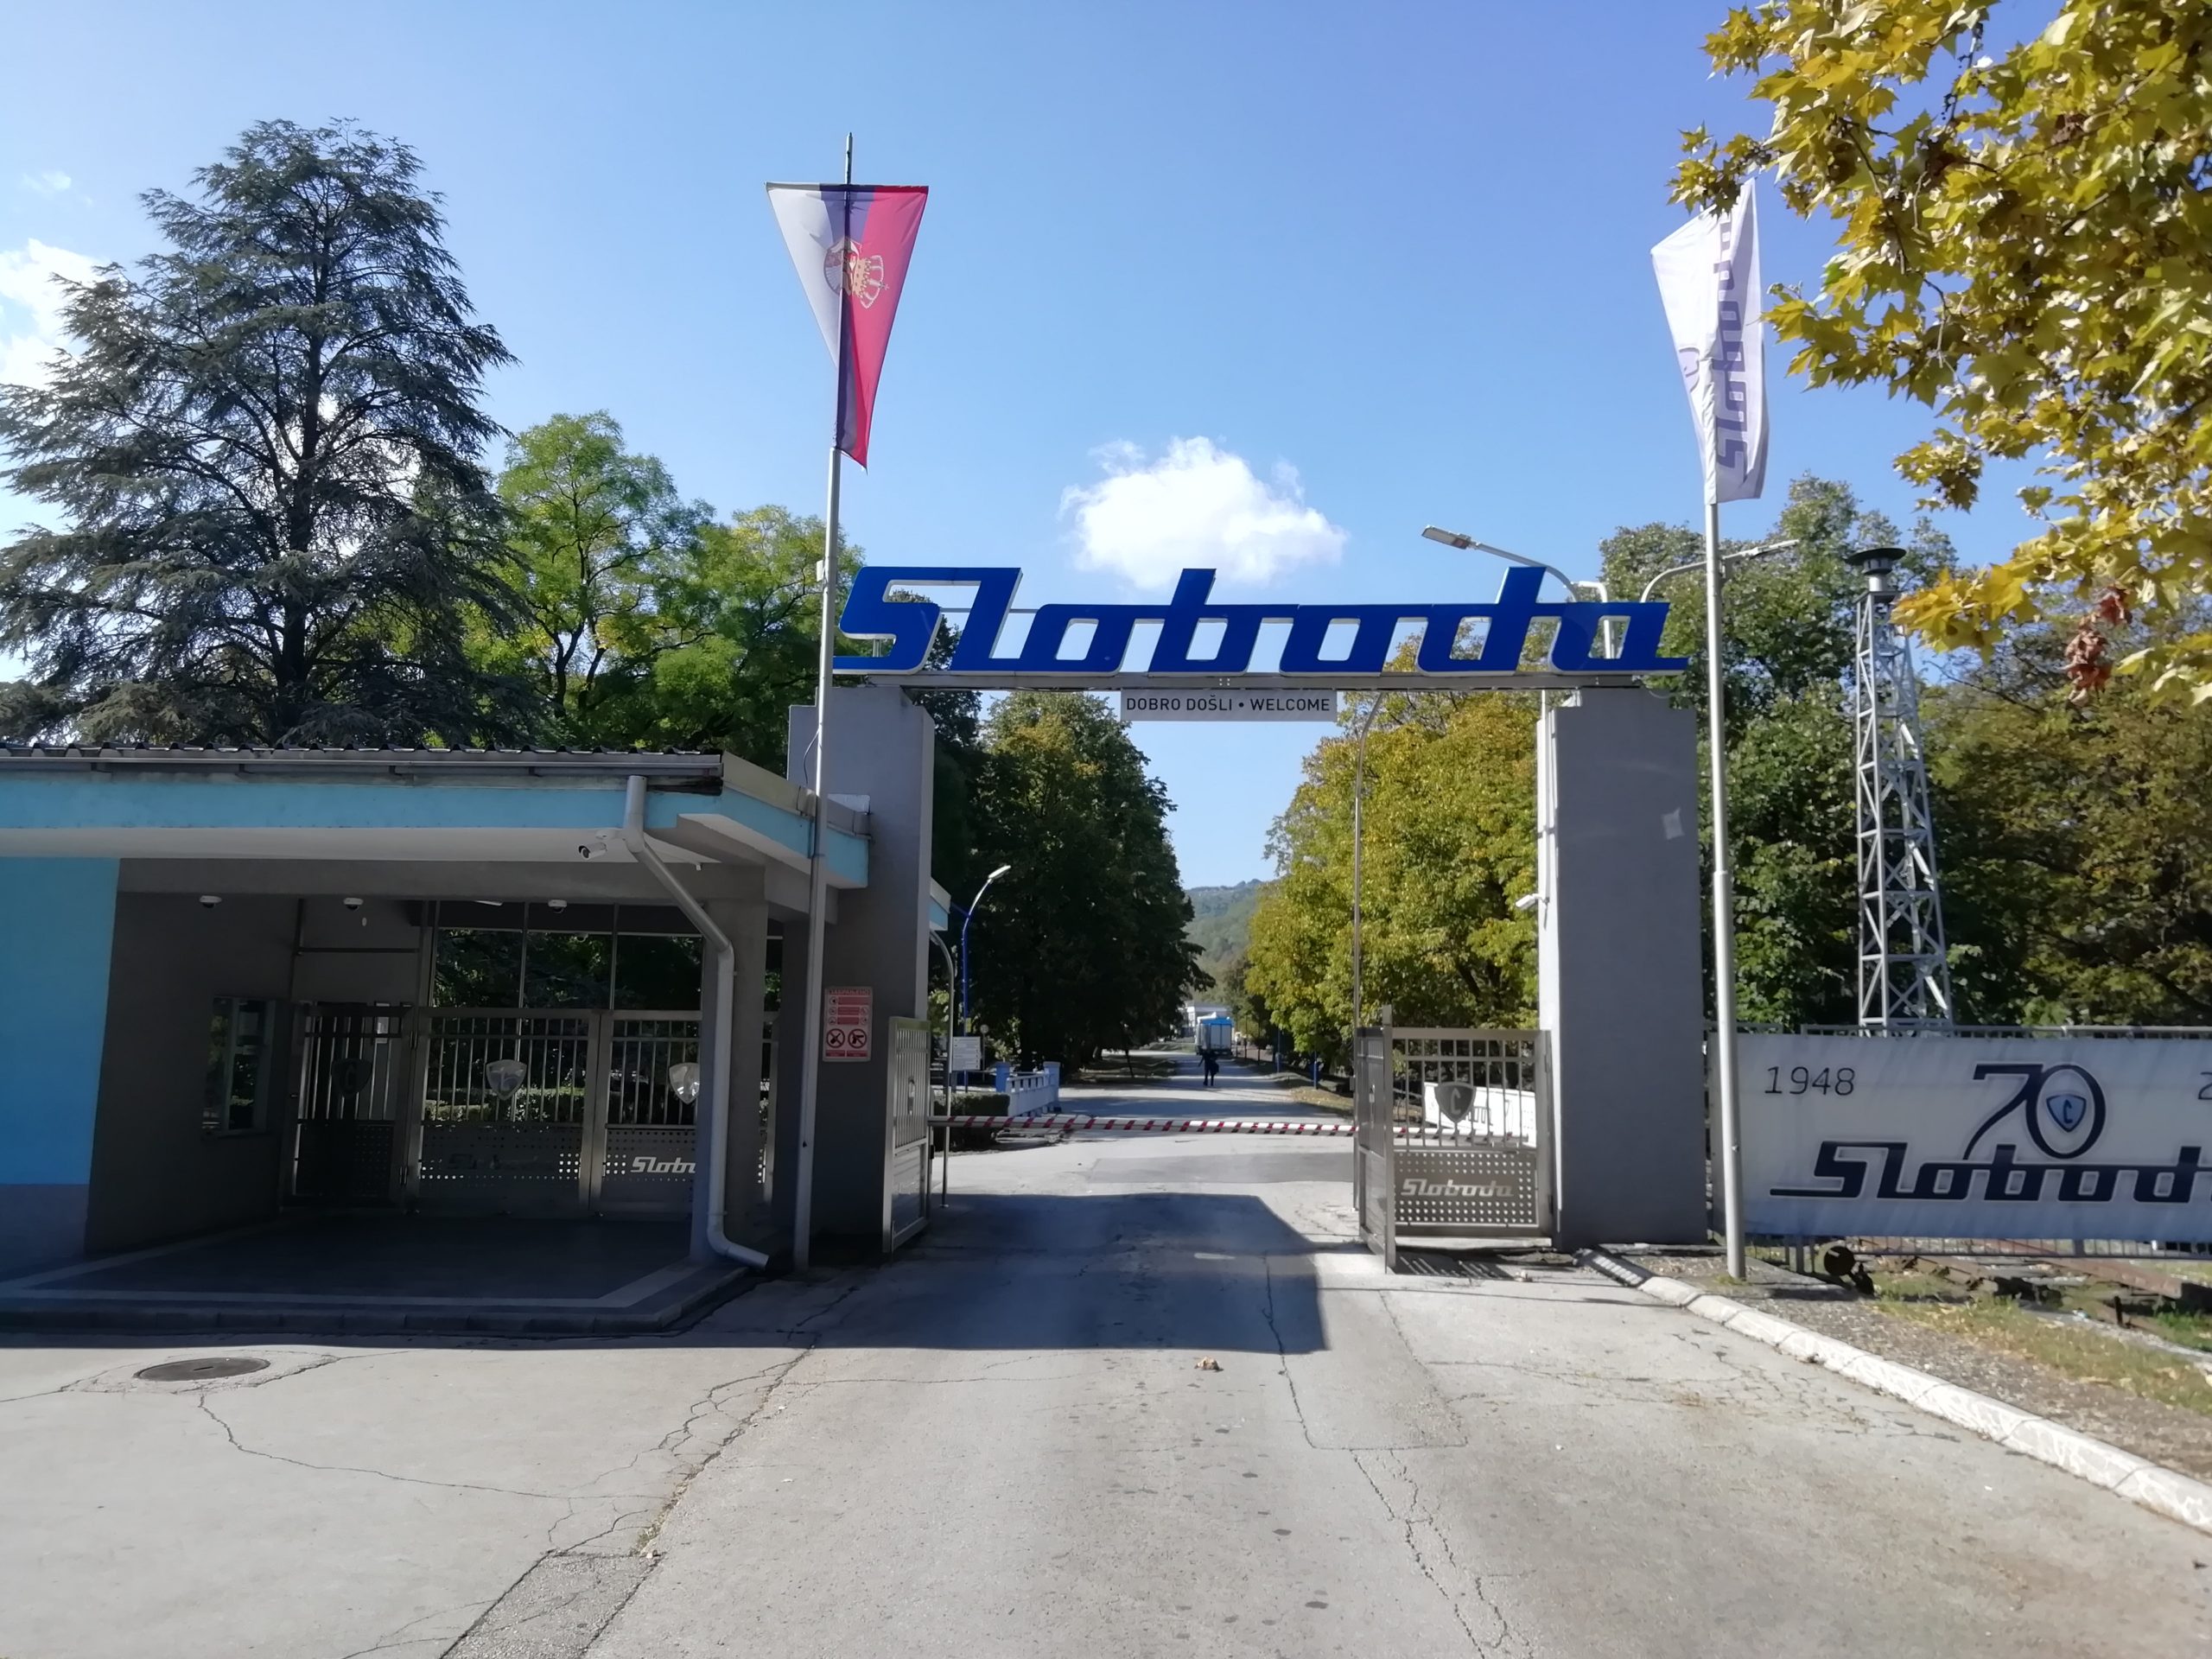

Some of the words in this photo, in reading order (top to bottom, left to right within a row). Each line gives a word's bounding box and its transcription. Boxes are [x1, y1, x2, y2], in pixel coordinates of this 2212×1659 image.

[832, 566, 1689, 675] Sloboda
[1126, 697, 1181, 711] DOBRO
[1186, 694, 1232, 711] DOŠLI
[1249, 697, 1331, 712] WELCOME
[1764, 1065, 1856, 1096] 1948
[1962, 1064, 2107, 1160] 70
[1400, 1178, 1515, 1197] Sloboda
[1770, 1141, 2212, 1203] Slobod
